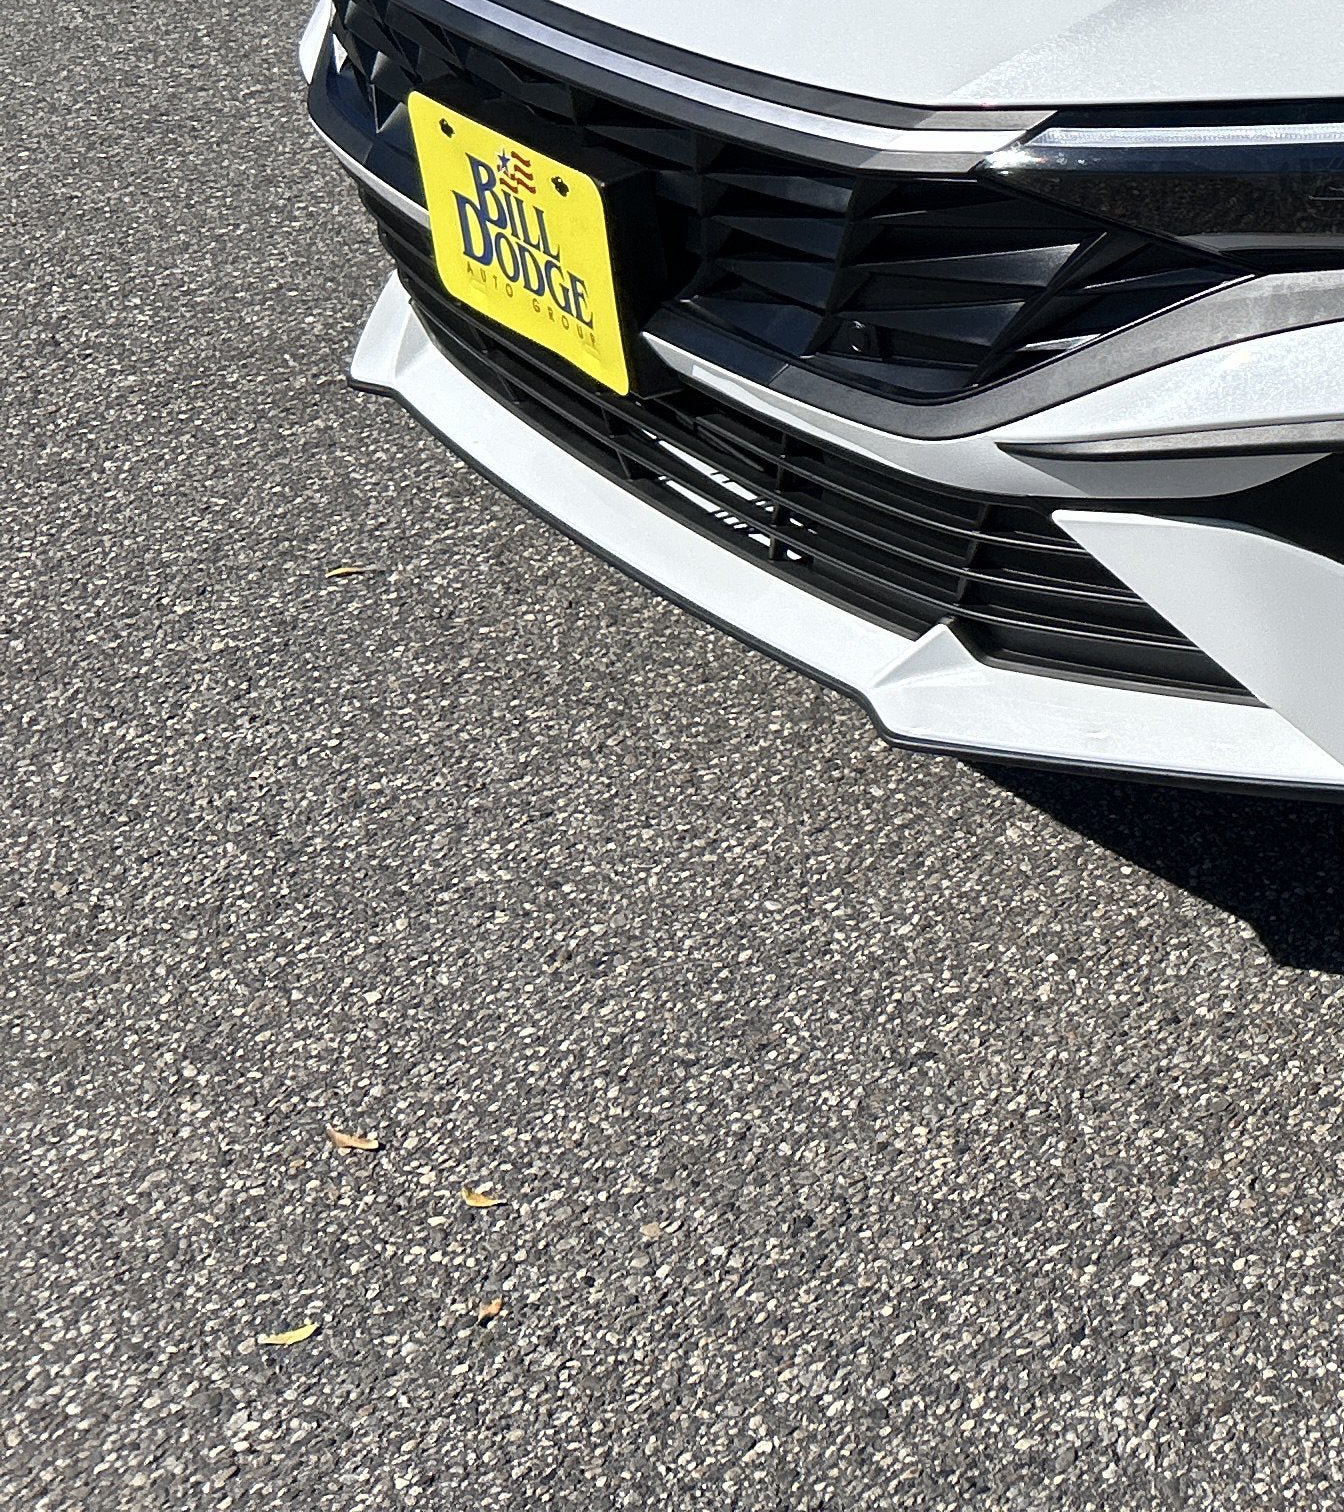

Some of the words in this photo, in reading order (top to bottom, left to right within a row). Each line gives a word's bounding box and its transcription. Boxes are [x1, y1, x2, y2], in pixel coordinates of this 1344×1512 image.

[451, 190, 595, 330] DODGE
[465, 152, 561, 263] BILL
[466, 261, 514, 298] AUTO
[532, 298, 598, 346] GROUP
